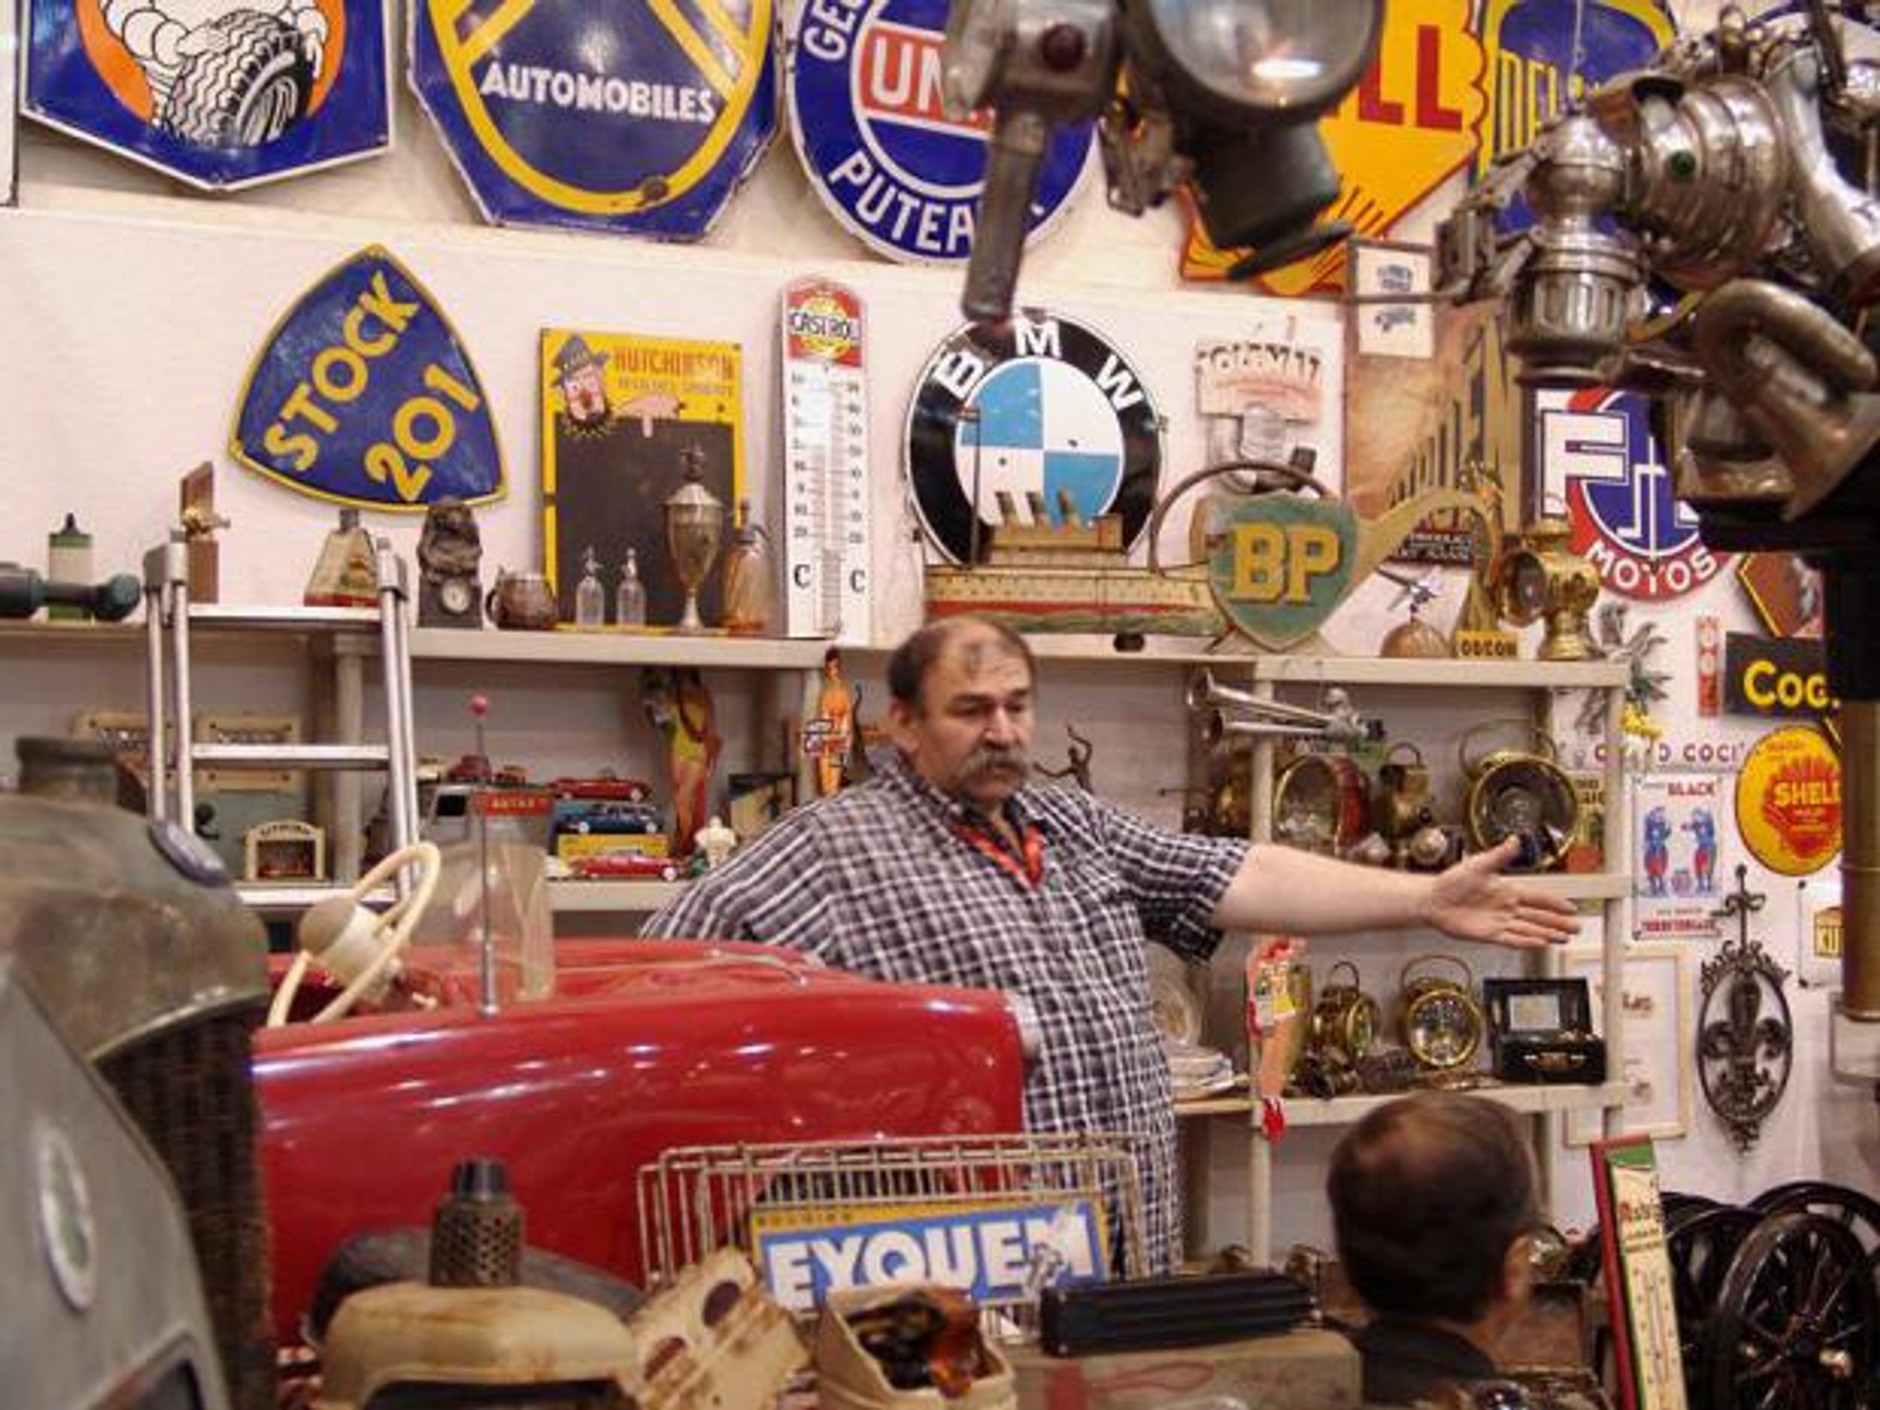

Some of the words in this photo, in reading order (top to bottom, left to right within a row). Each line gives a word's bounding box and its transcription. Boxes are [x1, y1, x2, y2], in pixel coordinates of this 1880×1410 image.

[480, 61, 715, 124] AUTOMOBILES
[1324, 24, 1462, 131] LL
[829, 150, 1044, 252] PUTEA
[265, 270, 419, 471] STOCK
[364, 363, 479, 500] 201
[794, 563, 811, 589] C
[850, 569, 866, 593] C
[1233, 522, 1341, 604] BP
